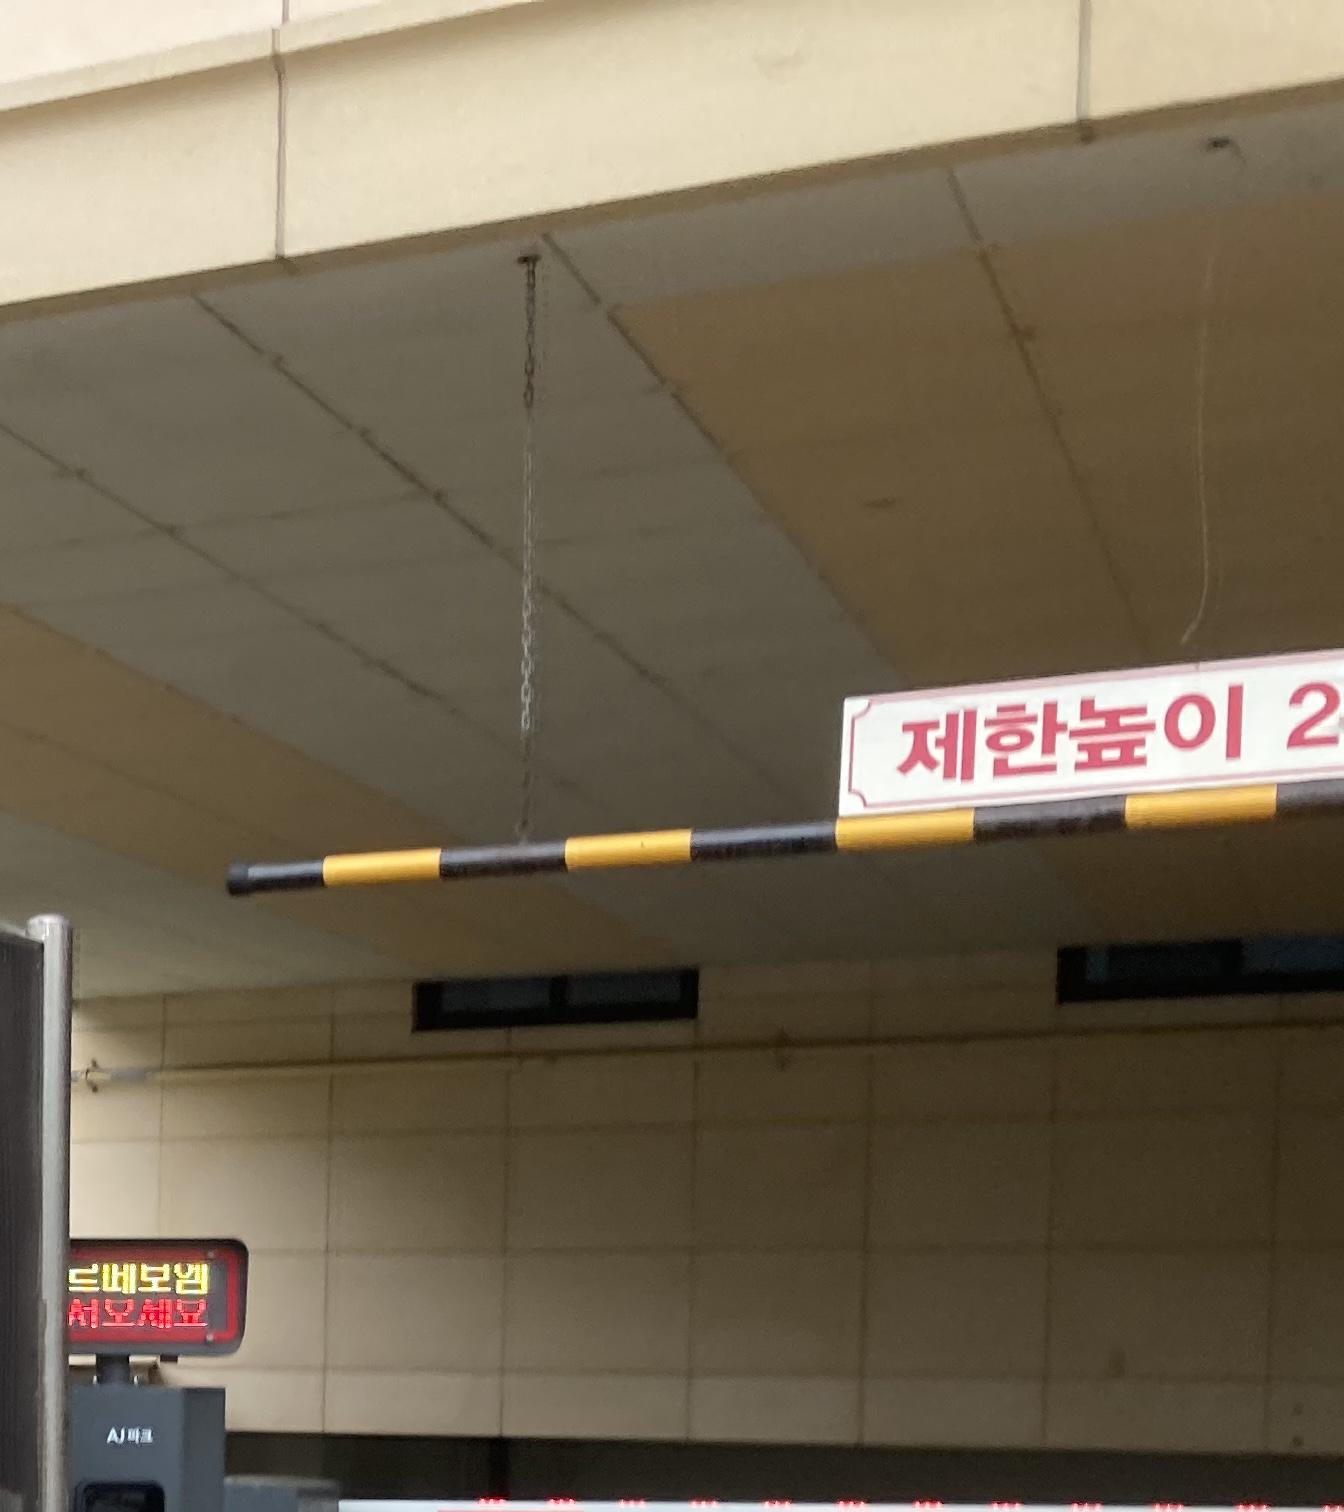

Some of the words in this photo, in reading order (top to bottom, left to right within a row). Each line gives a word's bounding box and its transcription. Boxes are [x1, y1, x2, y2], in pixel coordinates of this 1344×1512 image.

[897, 684, 1244, 781] 제한높이
[1287, 682, 1341, 750] 2
[68, 1298, 209, 1329] 서오세요
